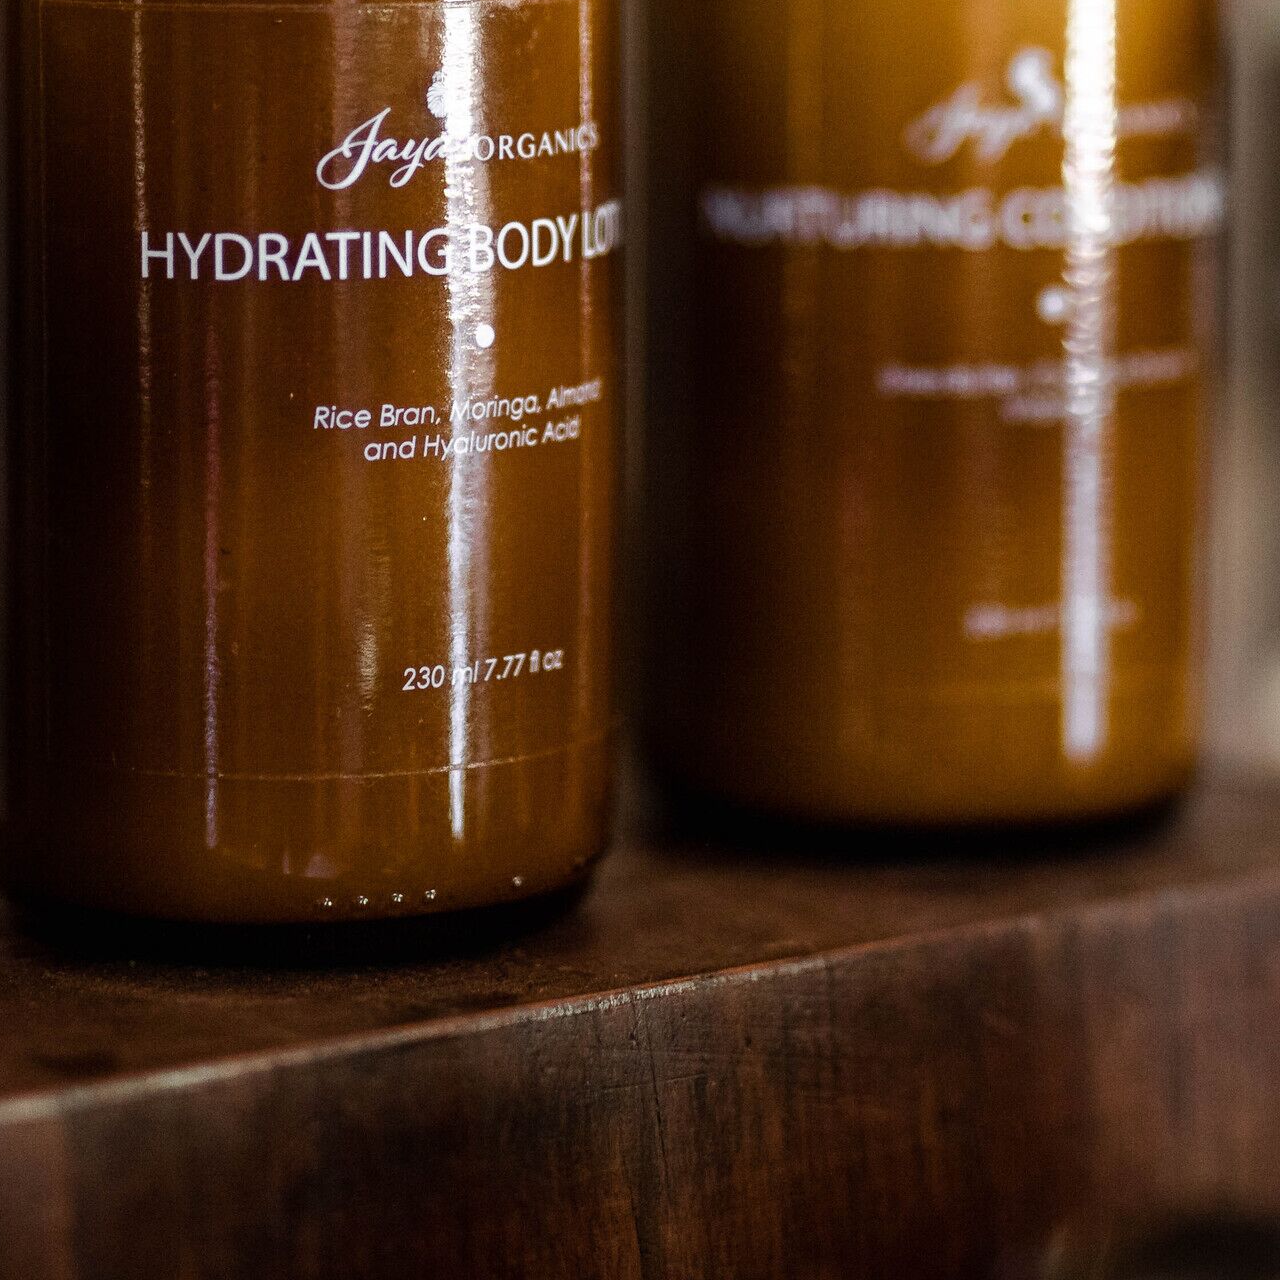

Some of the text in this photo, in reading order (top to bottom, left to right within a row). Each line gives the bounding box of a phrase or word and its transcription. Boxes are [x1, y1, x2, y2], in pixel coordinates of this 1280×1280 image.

[316, 107, 600, 190] Jaya ORGANICS
[140, 231, 452, 281] HYDRATING
[469, 214, 578, 273] BODY
[313, 405, 372, 429] Rice
[379, 403, 441, 428] Bran,
[450, 394, 541, 424] Moringa,
[363, 414, 581, 461] and Hyaluronic Acid
[402, 664, 445, 691] 230
[451, 660, 479, 686] ml
[484, 653, 526, 682] 7.77
